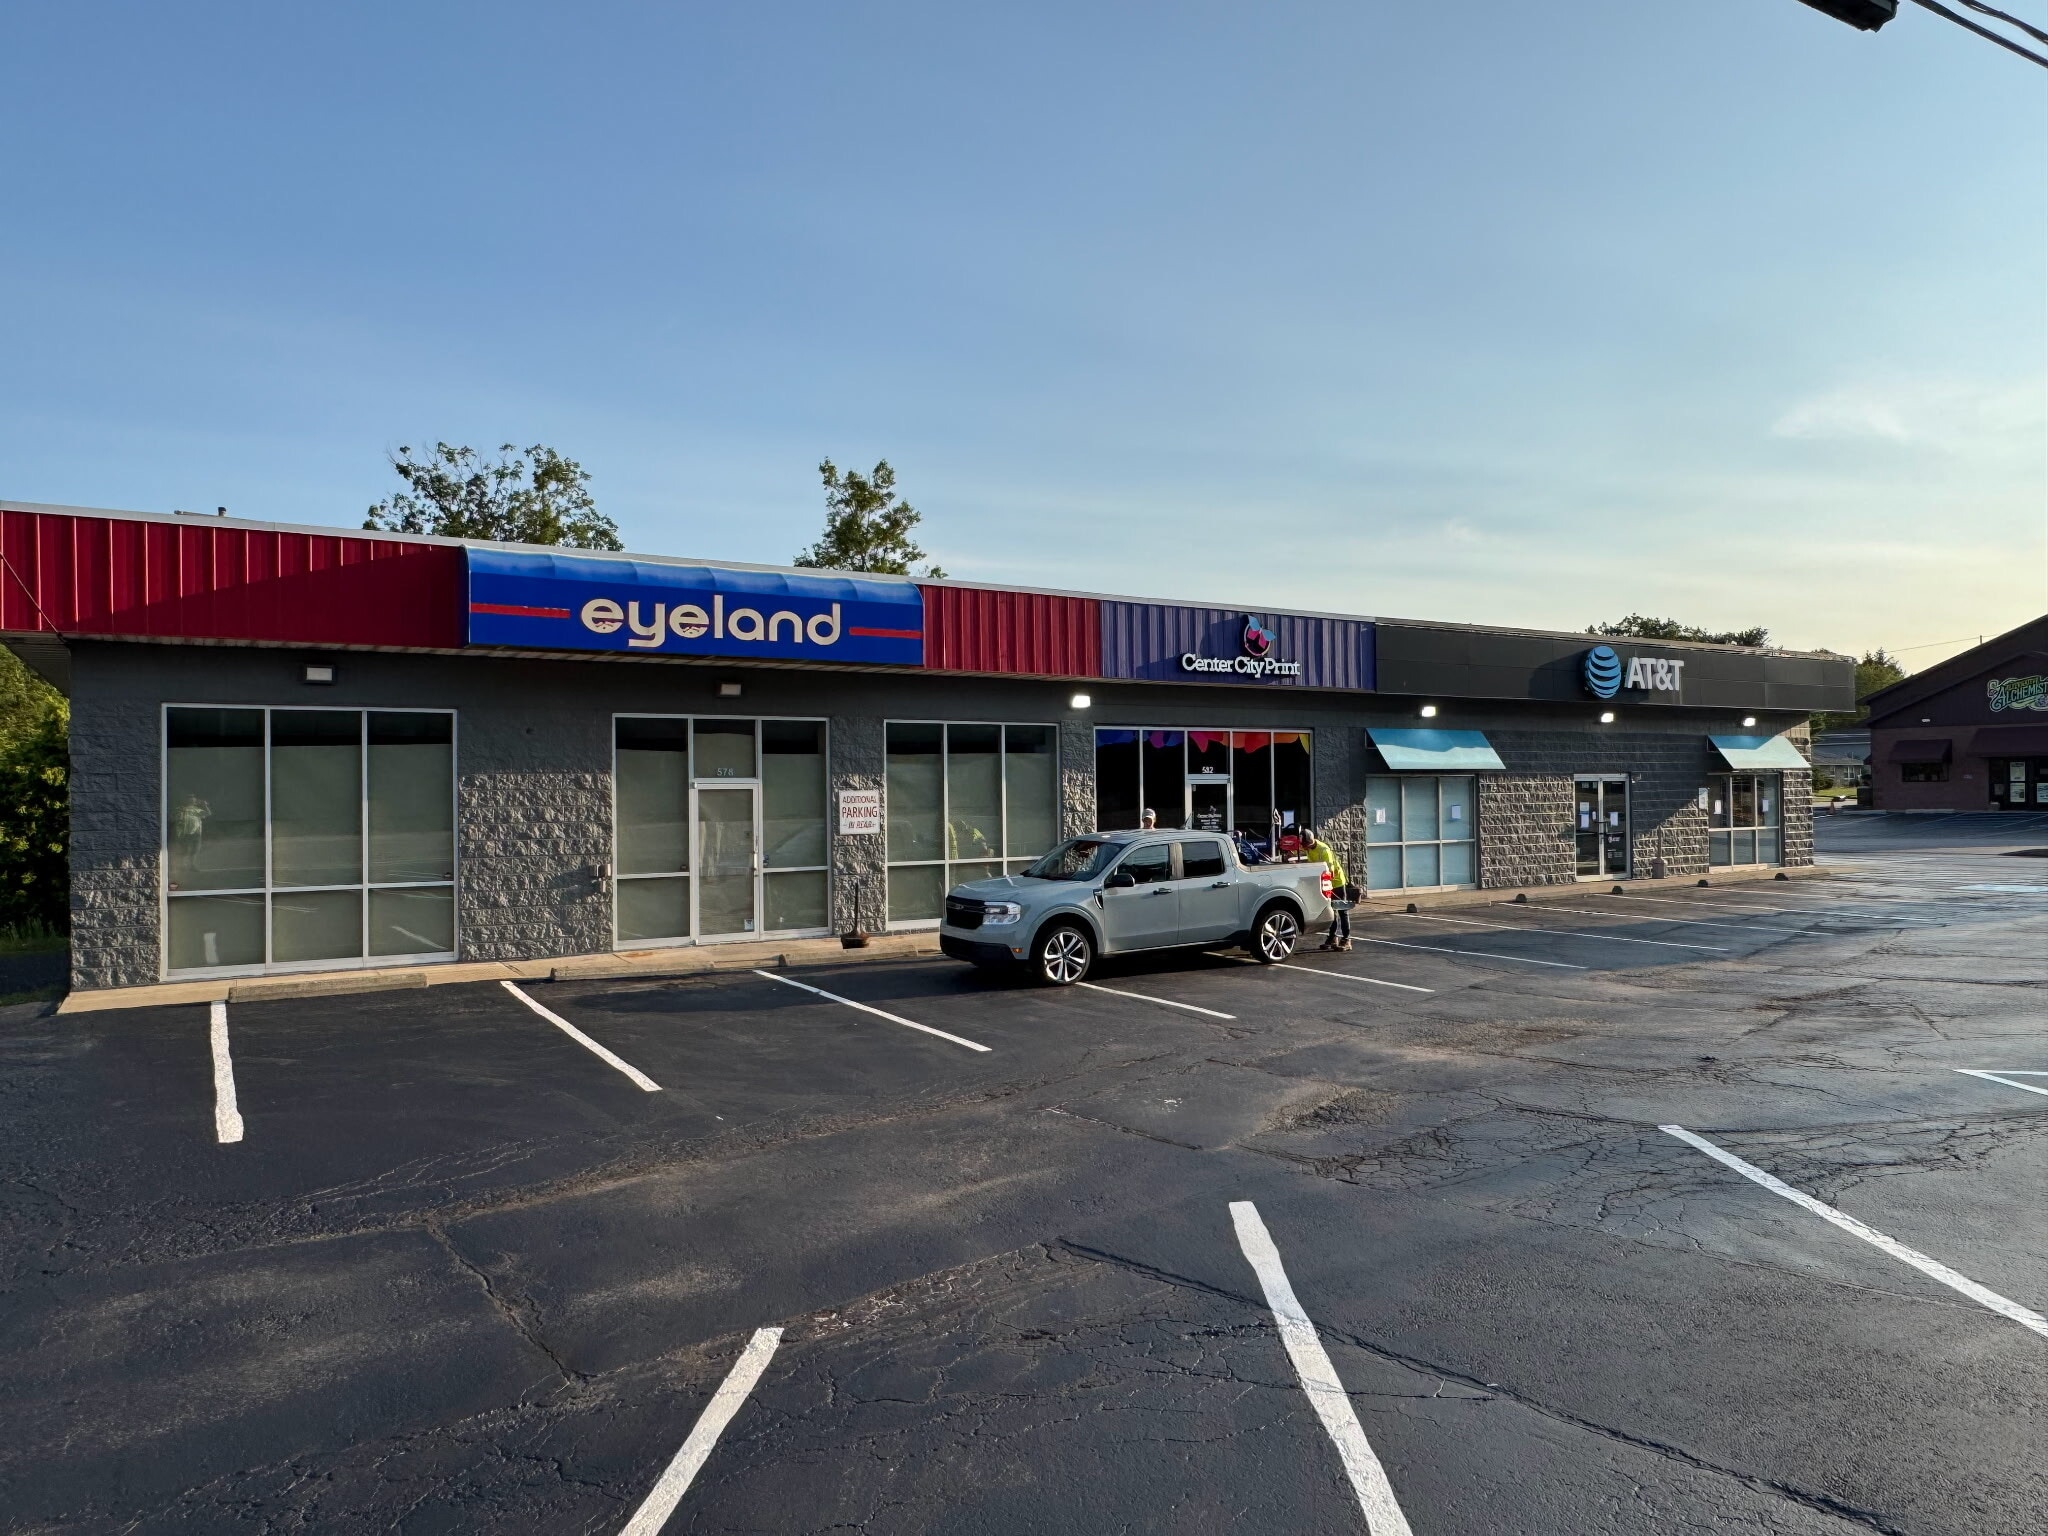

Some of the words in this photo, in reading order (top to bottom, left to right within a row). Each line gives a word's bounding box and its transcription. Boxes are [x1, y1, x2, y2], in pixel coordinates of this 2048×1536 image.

[581, 594, 841, 648] eyeland
[1182, 653, 1234, 673] Center
[1234, 656, 1264, 678] City
[1264, 657, 1300, 675] Print
[1624, 656, 1685, 691] AT&T
[842, 806, 878, 818] PARKING
